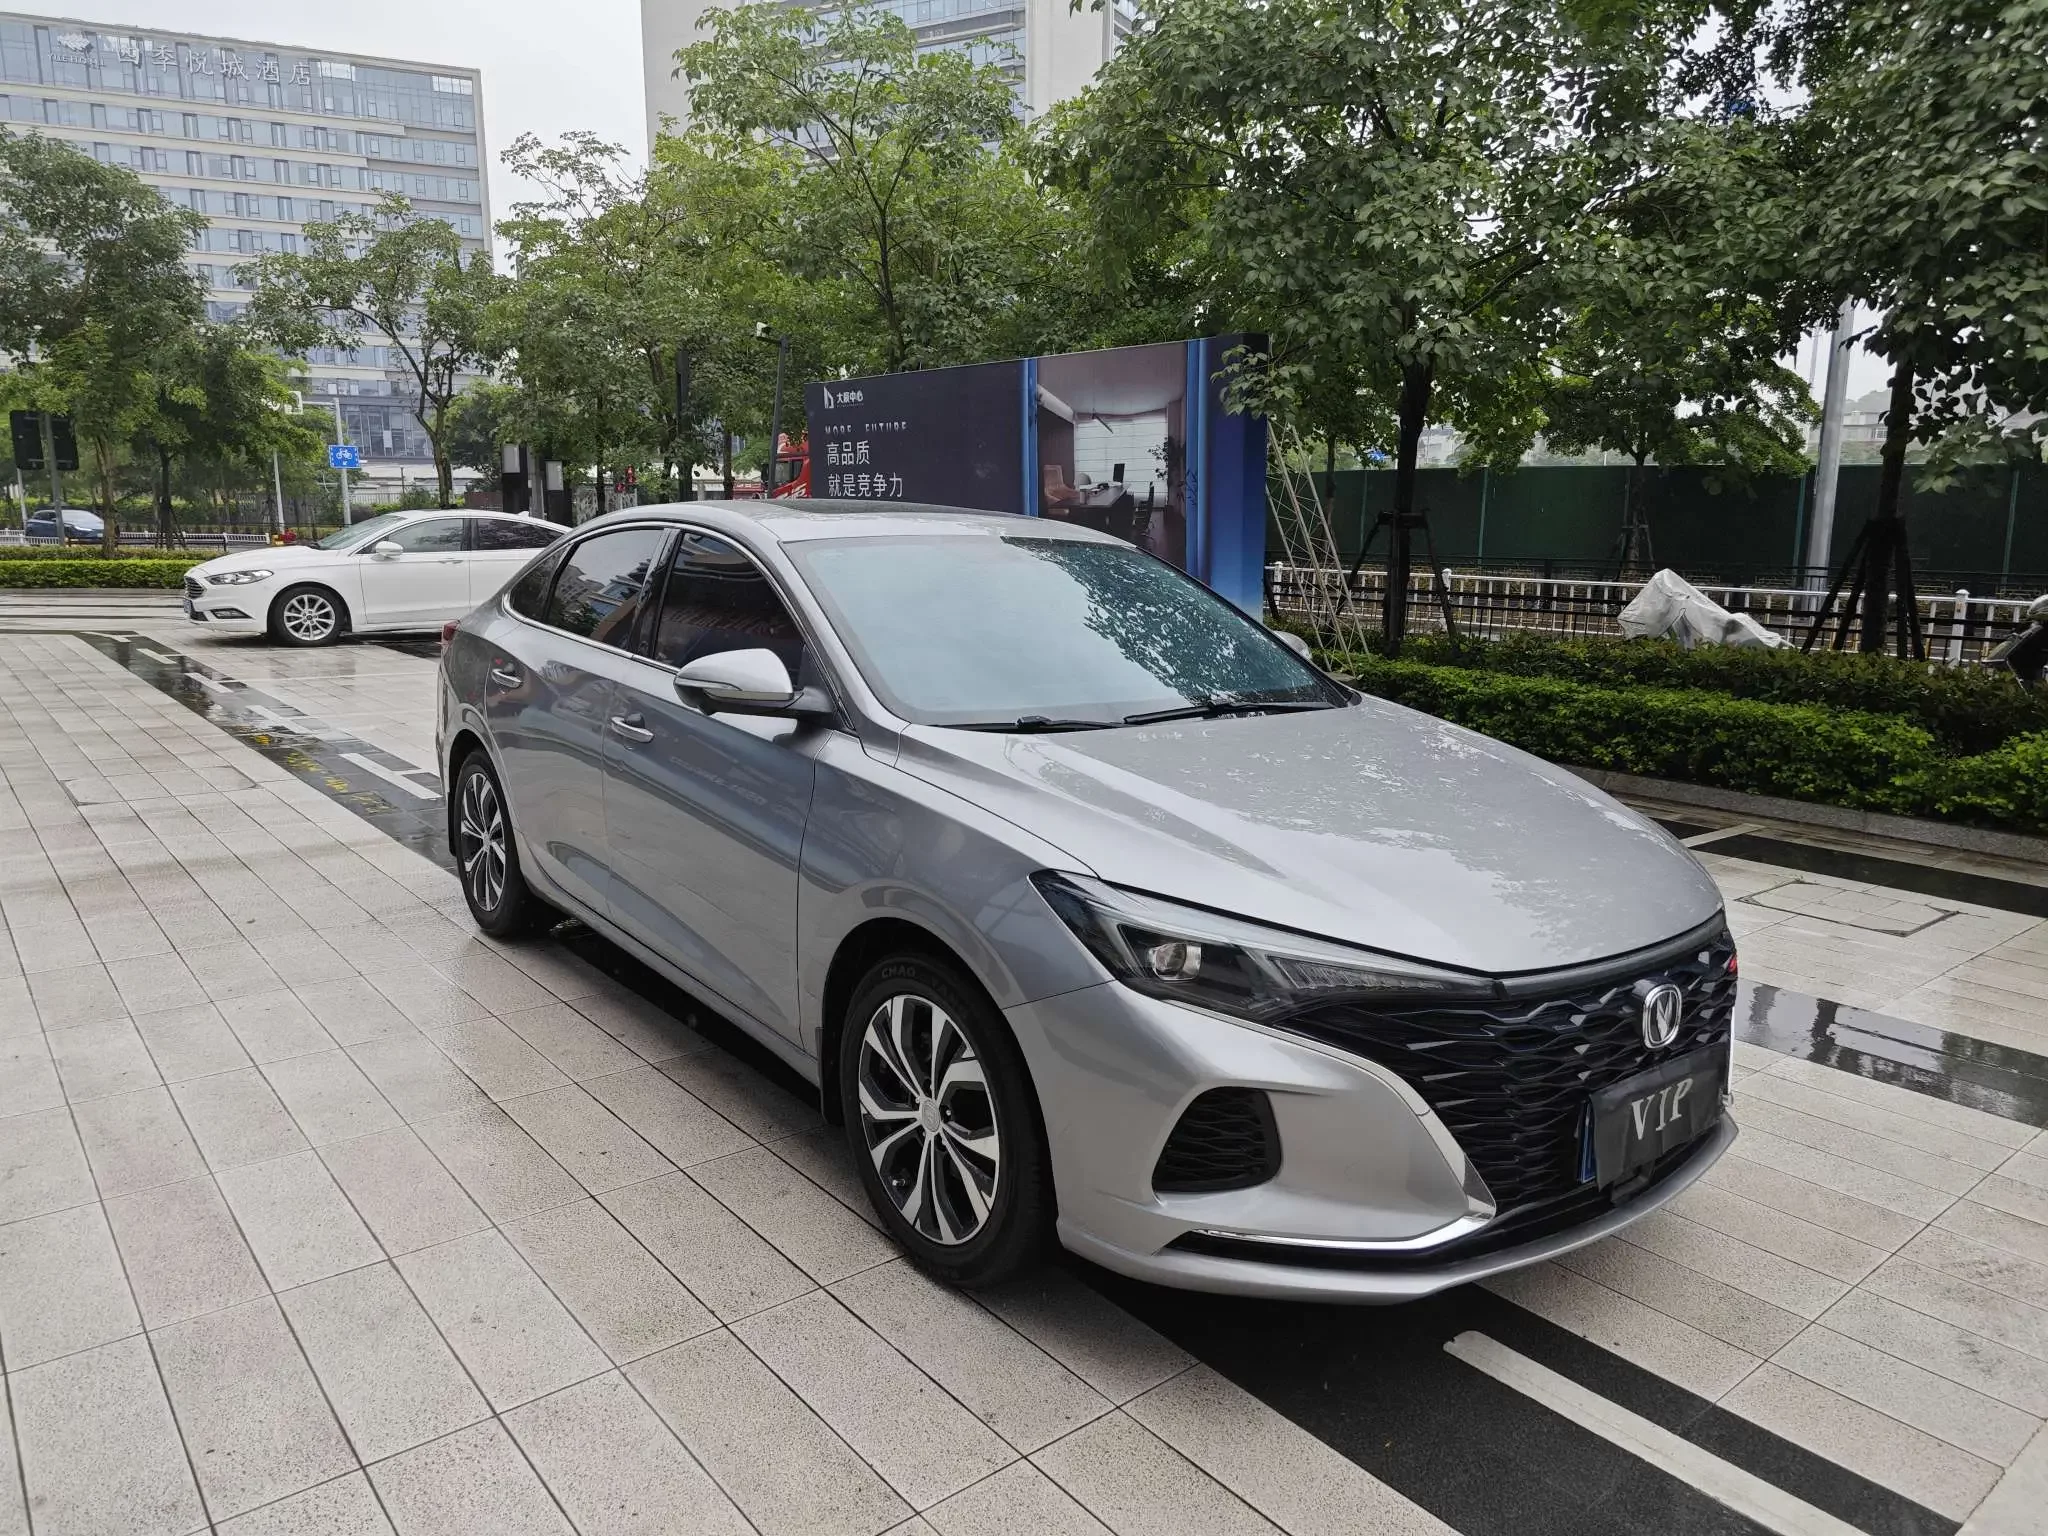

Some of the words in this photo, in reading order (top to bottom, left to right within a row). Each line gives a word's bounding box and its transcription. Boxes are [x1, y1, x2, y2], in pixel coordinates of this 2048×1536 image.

[117, 39, 312, 86] 四季悦城酒店
[826, 440, 870, 466] 高品质
[828, 472, 904, 498] 就是竞争力
[1631, 1078, 1693, 1140] VIP
